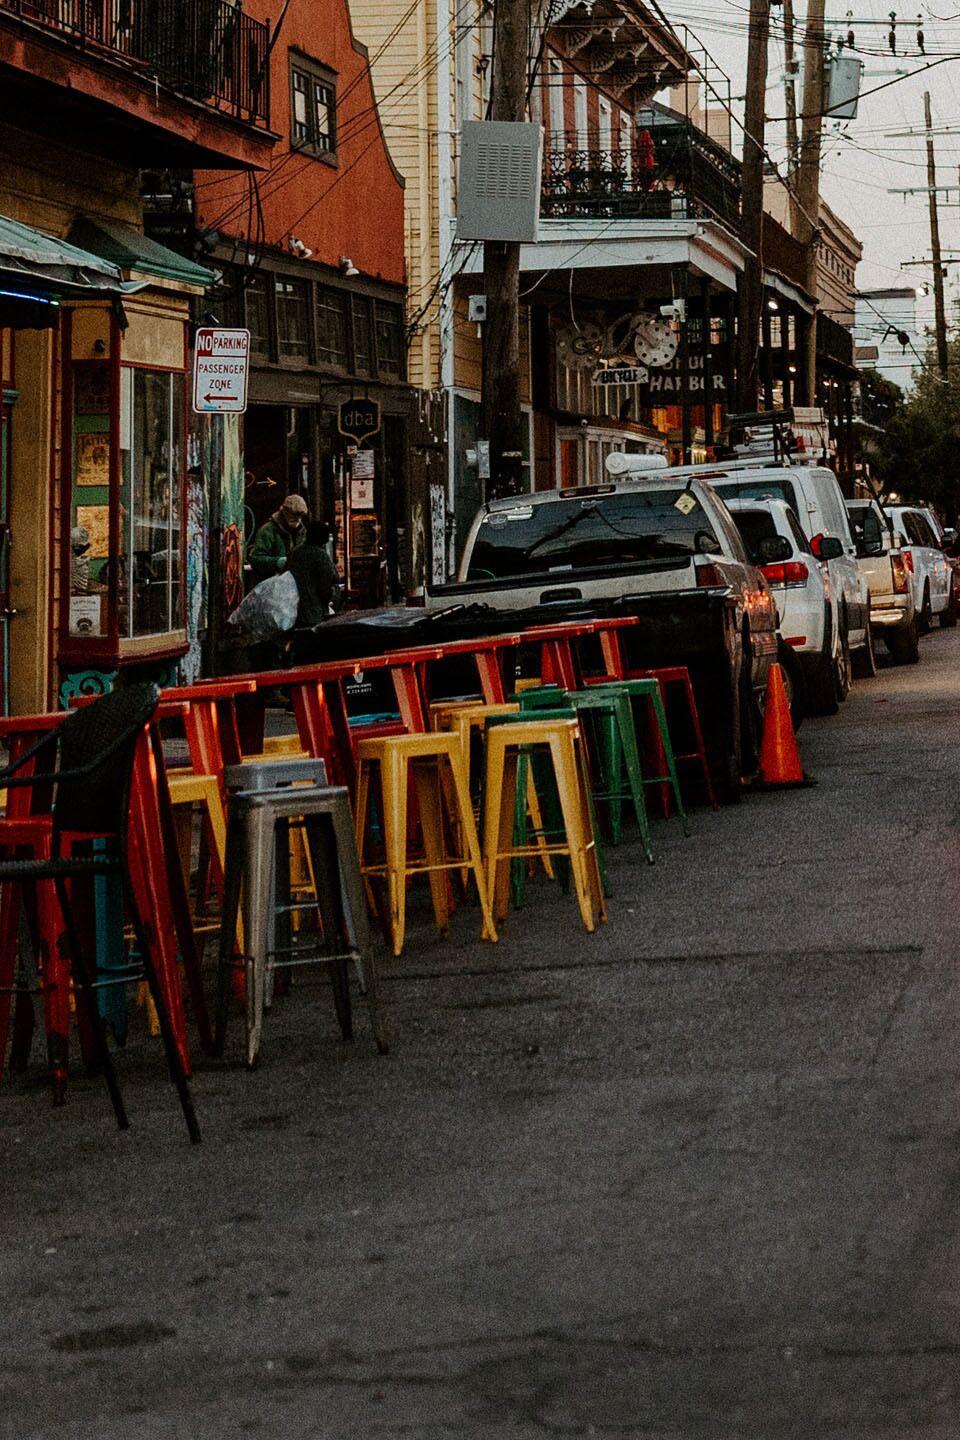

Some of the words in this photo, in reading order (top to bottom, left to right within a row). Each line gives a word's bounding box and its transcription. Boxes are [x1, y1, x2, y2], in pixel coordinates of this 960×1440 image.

[197, 335, 213, 351] NO
[213, 337, 247, 350] PARKING
[199, 363, 245, 375] PASSENGER
[209, 379, 233, 389] ZONE
[600, 370, 639, 384] BICYCLE
[344, 410, 375, 426] dba
